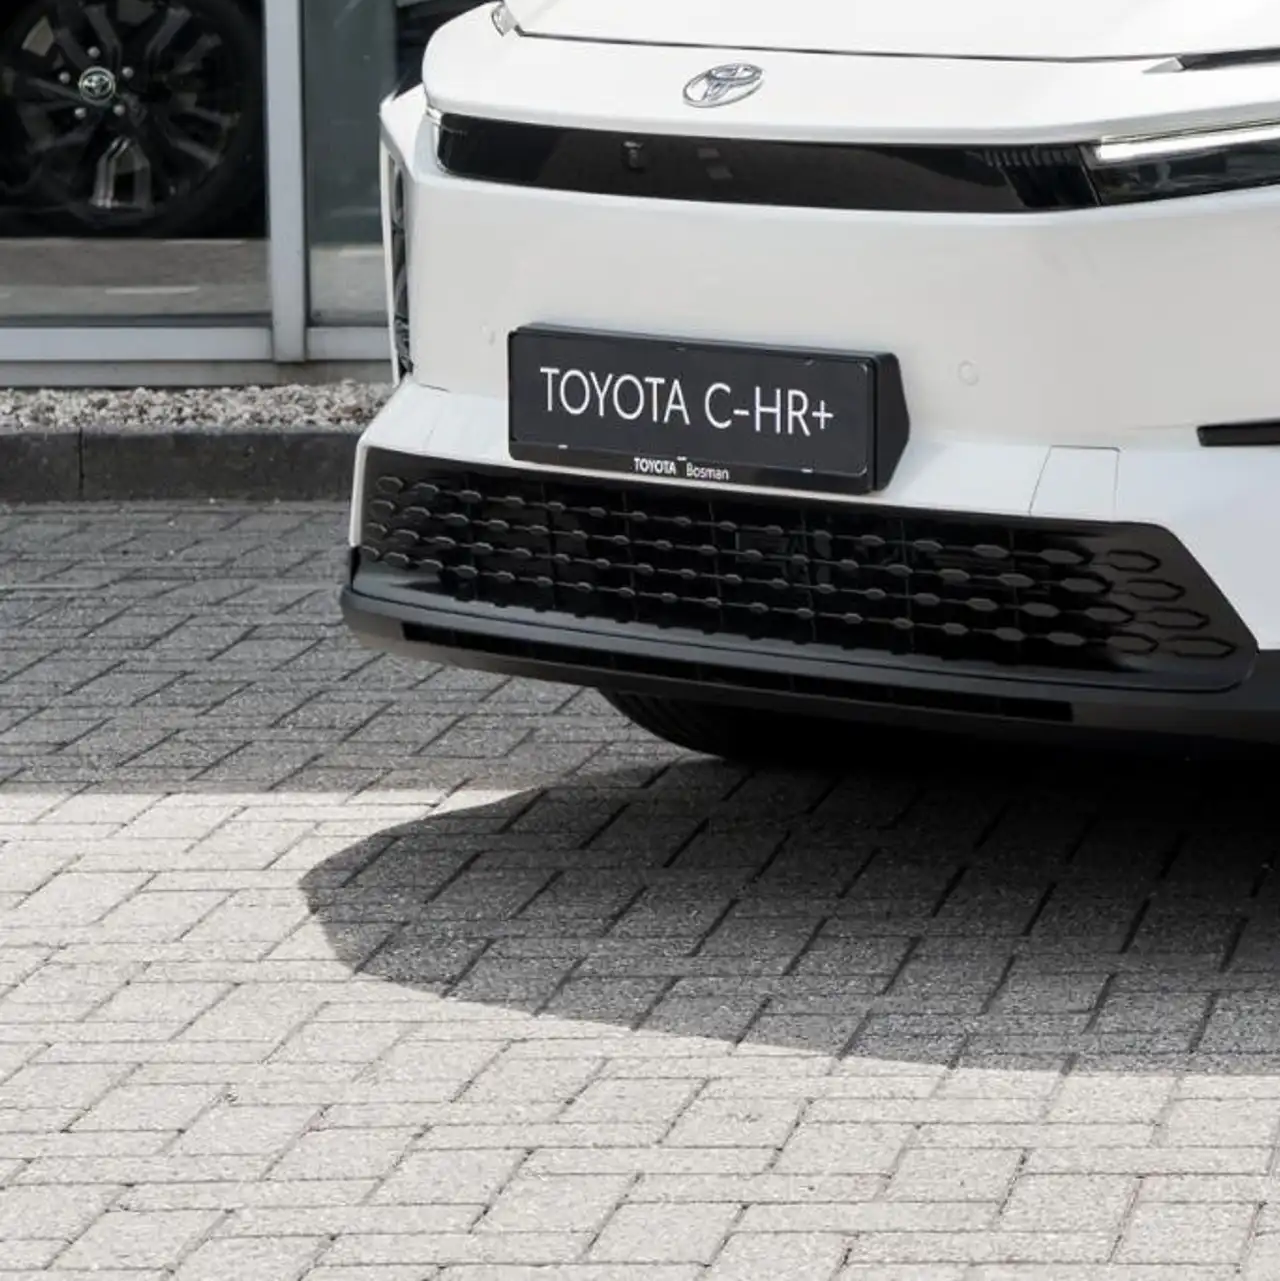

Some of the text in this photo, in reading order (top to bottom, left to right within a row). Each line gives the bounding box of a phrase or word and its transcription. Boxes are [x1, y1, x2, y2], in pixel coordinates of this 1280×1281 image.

[540, 366, 834, 437] TOYOTA C-HR+
[634, 457, 729, 482] TOYOTA Bosman
